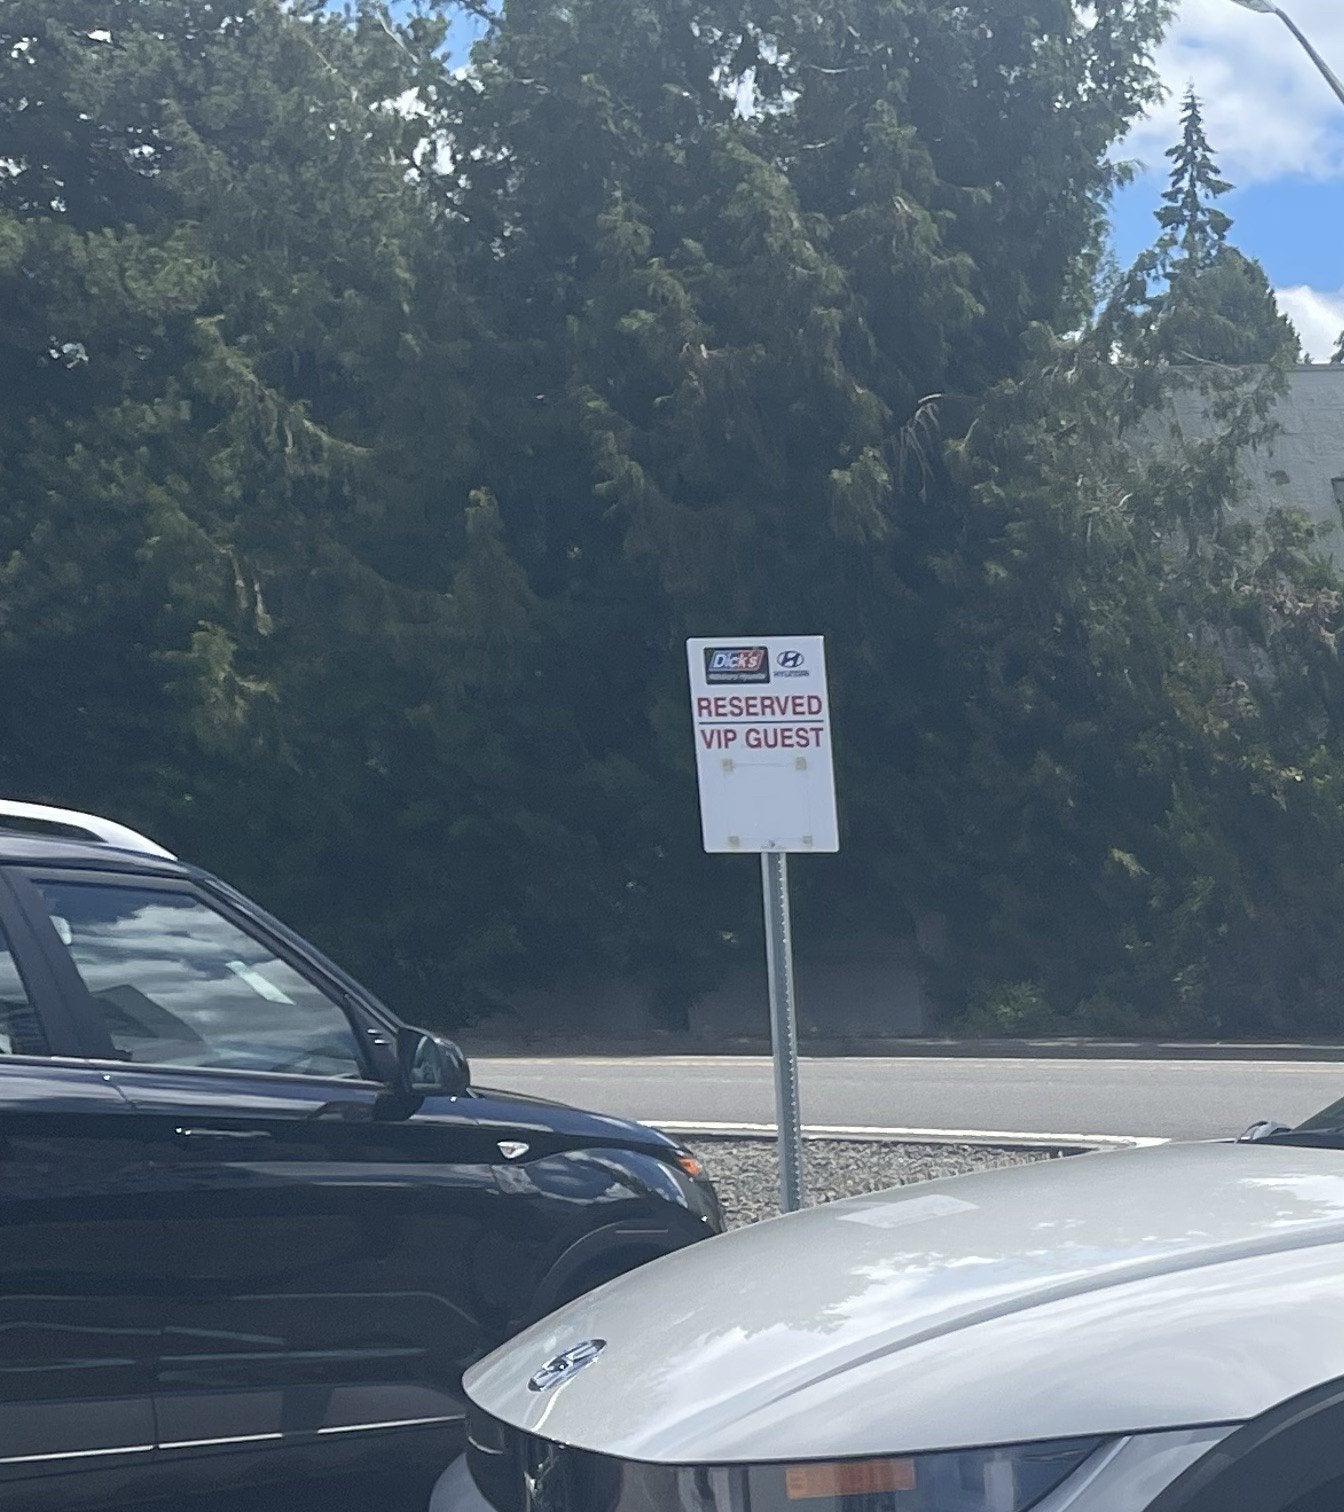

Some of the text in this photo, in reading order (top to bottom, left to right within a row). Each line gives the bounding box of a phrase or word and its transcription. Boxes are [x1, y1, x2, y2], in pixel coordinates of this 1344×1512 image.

[697, 695, 823, 717] RESERVED
[700, 727, 824, 749] VIP GUEST
